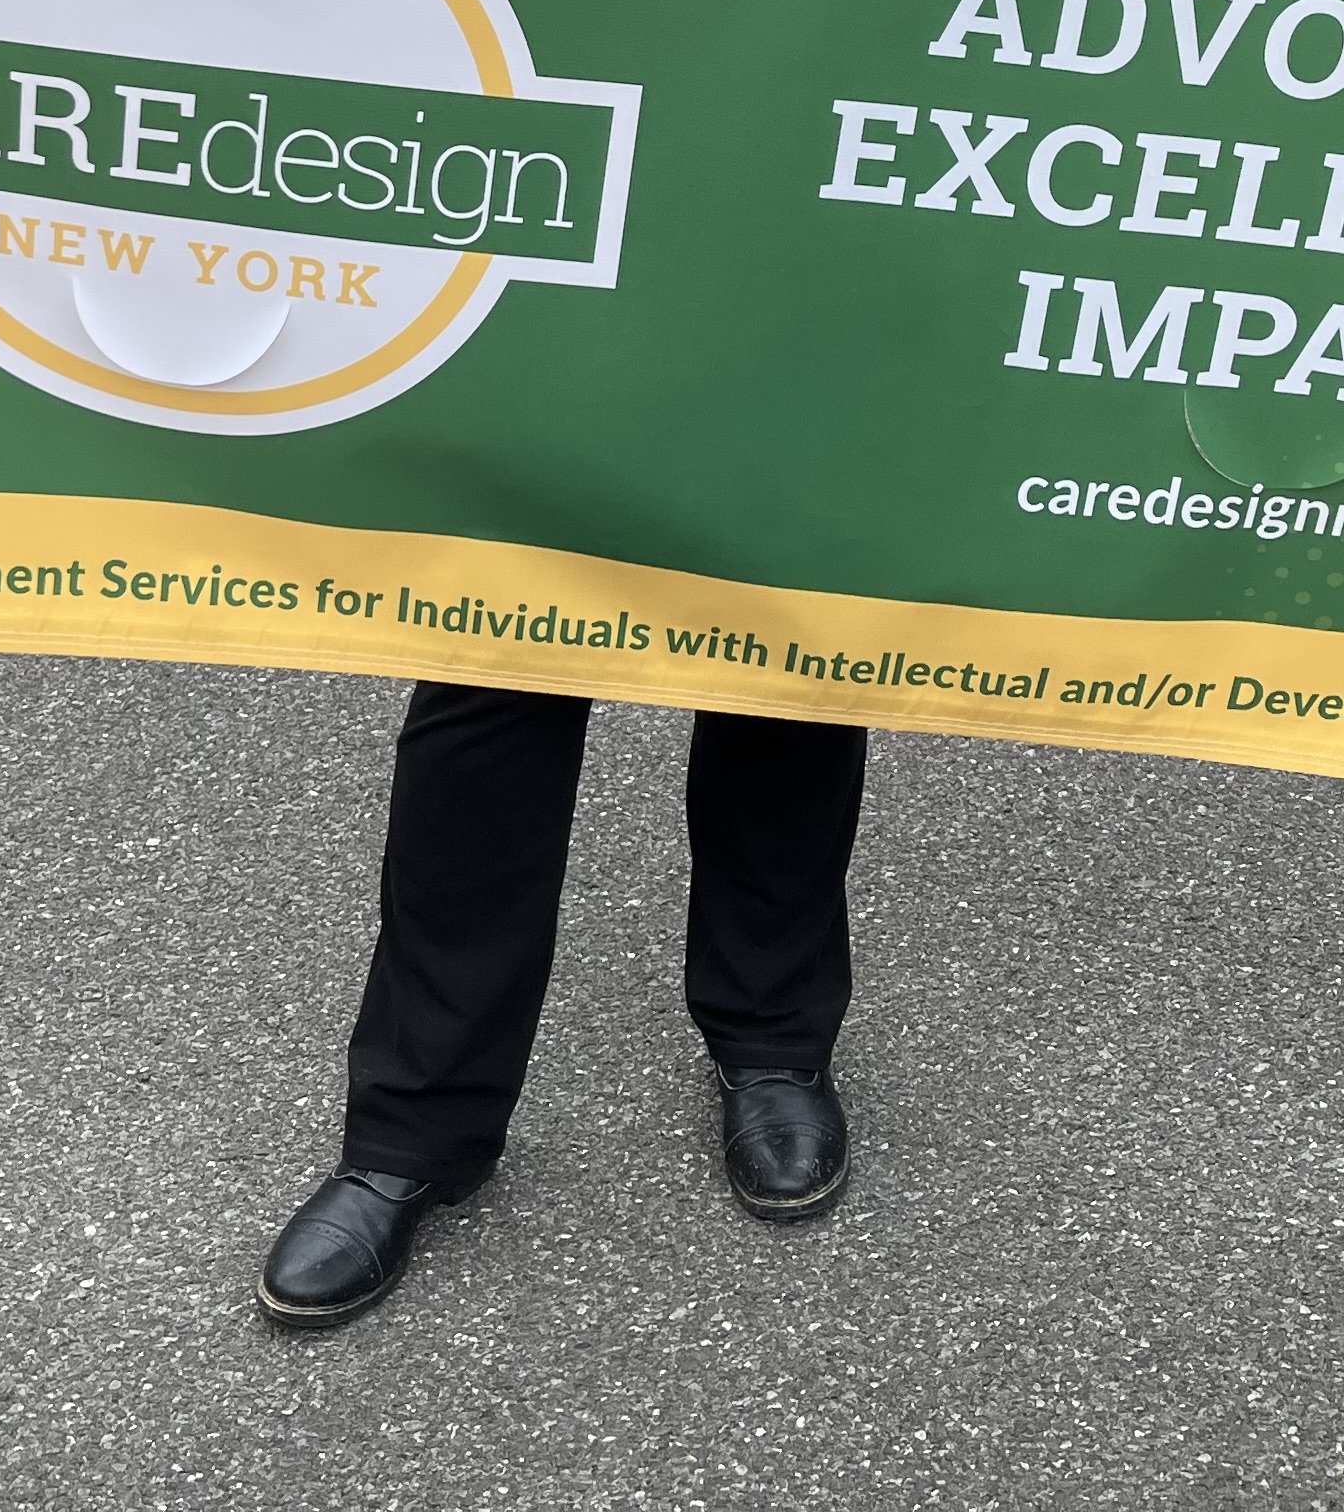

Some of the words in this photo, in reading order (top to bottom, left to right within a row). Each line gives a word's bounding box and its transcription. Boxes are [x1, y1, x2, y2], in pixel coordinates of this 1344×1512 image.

[189, 242, 382, 308] YORK
[100, 559, 299, 610] Services
[315, 578, 384, 618] for
[397, 586, 652, 651] Individuals
[666, 626, 769, 668] with
[784, 642, 1051, 700] Intellectual
[1059, 673, 1217, 711] and/or
